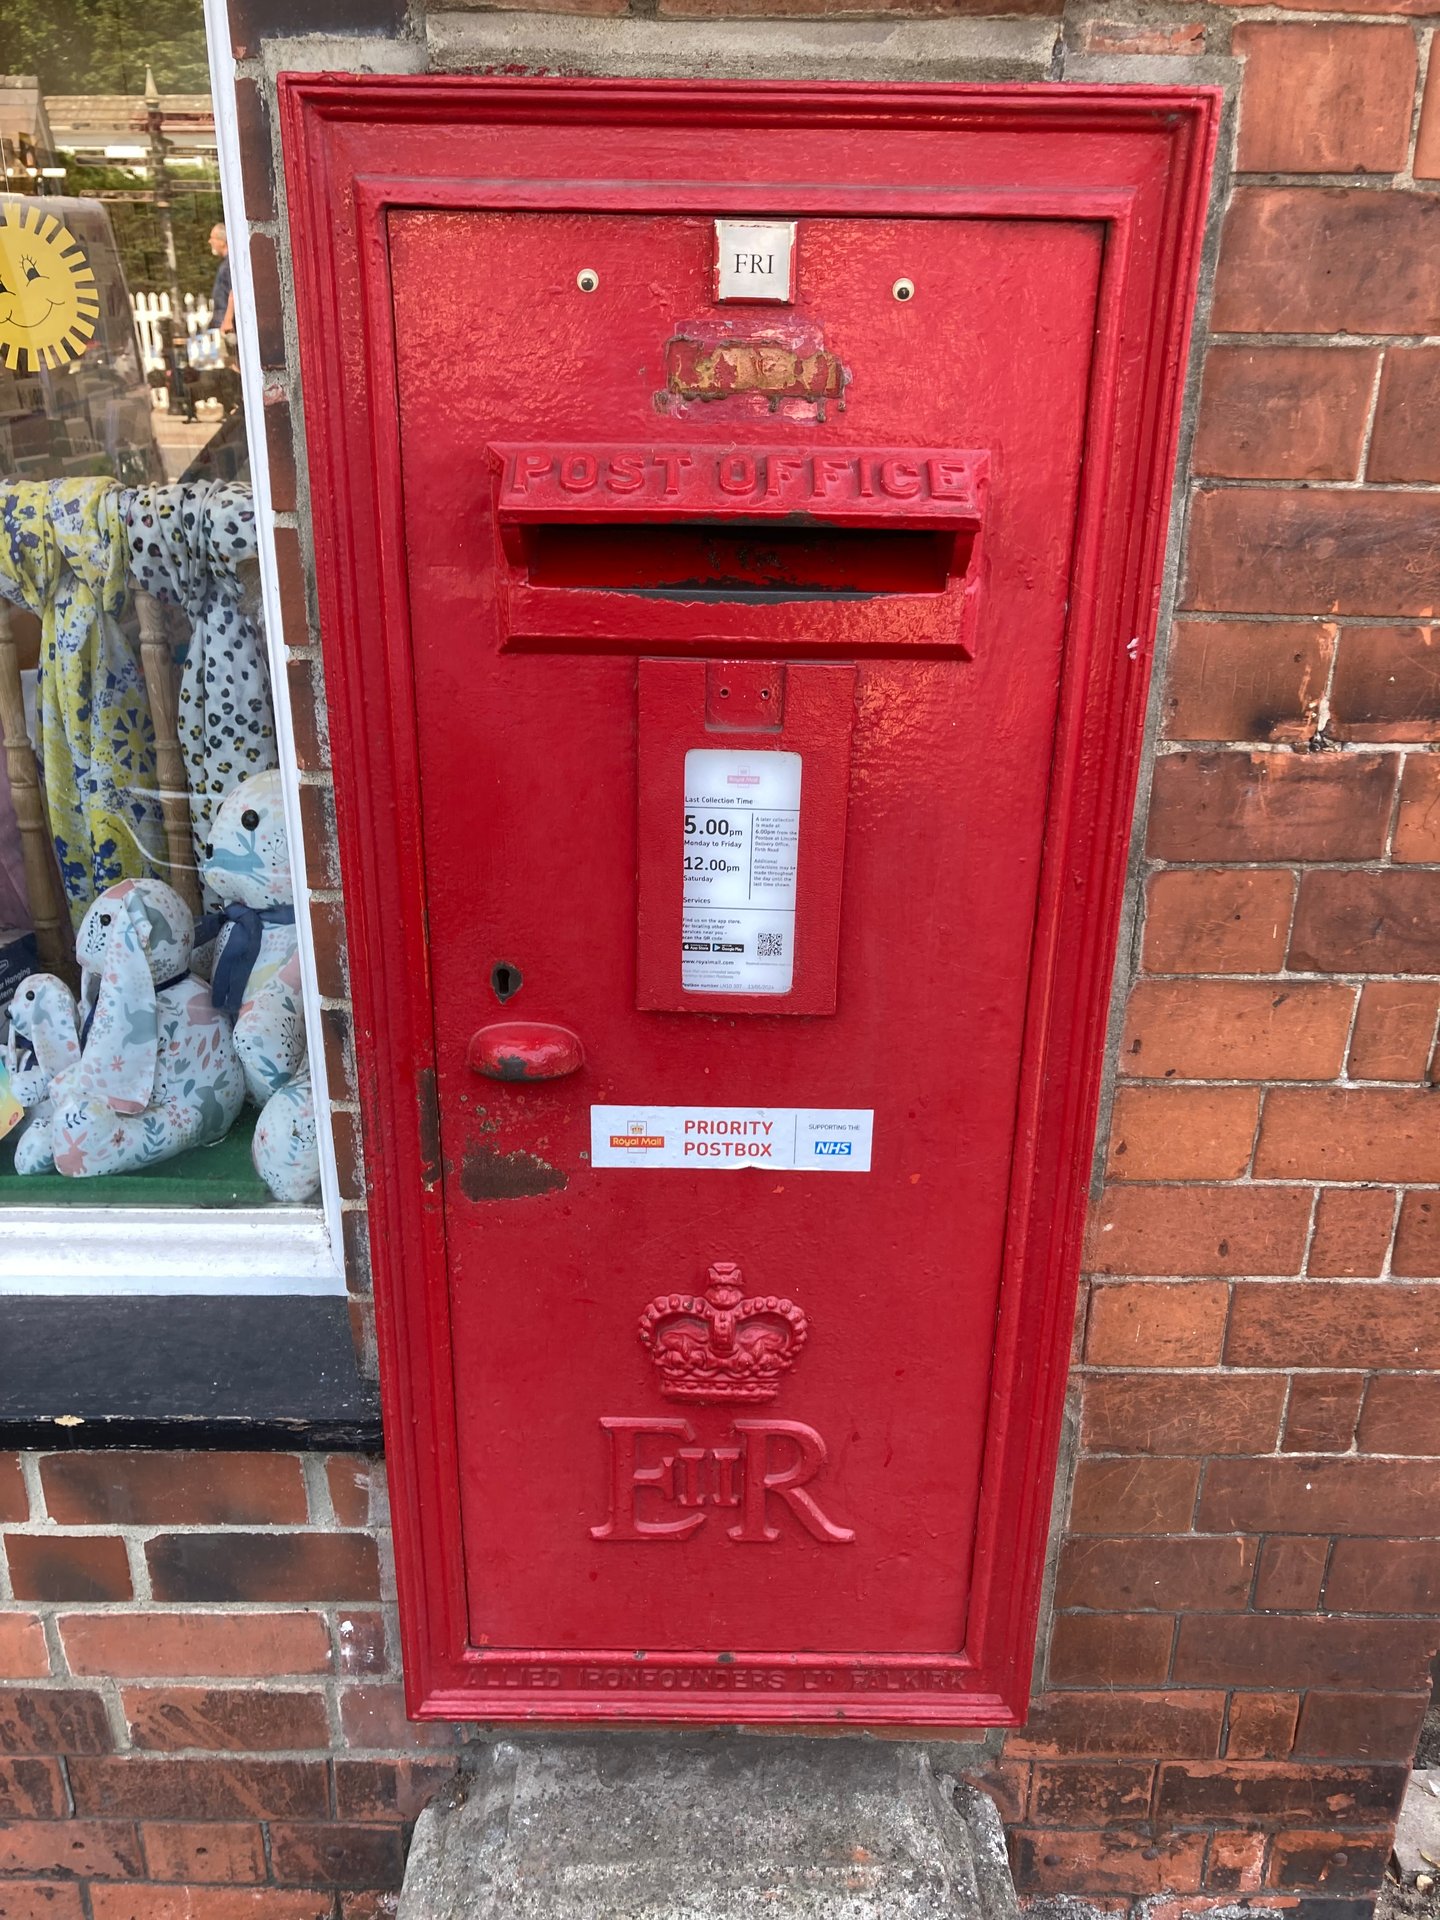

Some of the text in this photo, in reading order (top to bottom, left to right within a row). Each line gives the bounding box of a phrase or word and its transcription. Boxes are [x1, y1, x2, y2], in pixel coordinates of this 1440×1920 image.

[734, 253, 775, 275] FRI
[511, 449, 970, 501] POST OFFICE
[702, 796, 734, 804] Collection
[736, 797, 753, 805] Time
[684, 814, 743, 837] 5.00pm
[684, 839, 711, 848] Monday
[721, 840, 742, 849] Friday
[683, 856, 740, 873] 12.00pm
[683, 874, 714, 883] Saturday
[683, 896, 711, 904] Services
[684, 1120, 774, 1136] PRIORITY
[612, 1137, 662, 1147] Royal Mail
[684, 1142, 773, 1157] POSTBOX
[815, 1142, 850, 1155] NHS
[464, 1667, 562, 1687] ALLIED
[578, 1667, 786, 1690] IRONFOUNDERS
[850, 1670, 968, 1690] FALKIRK
